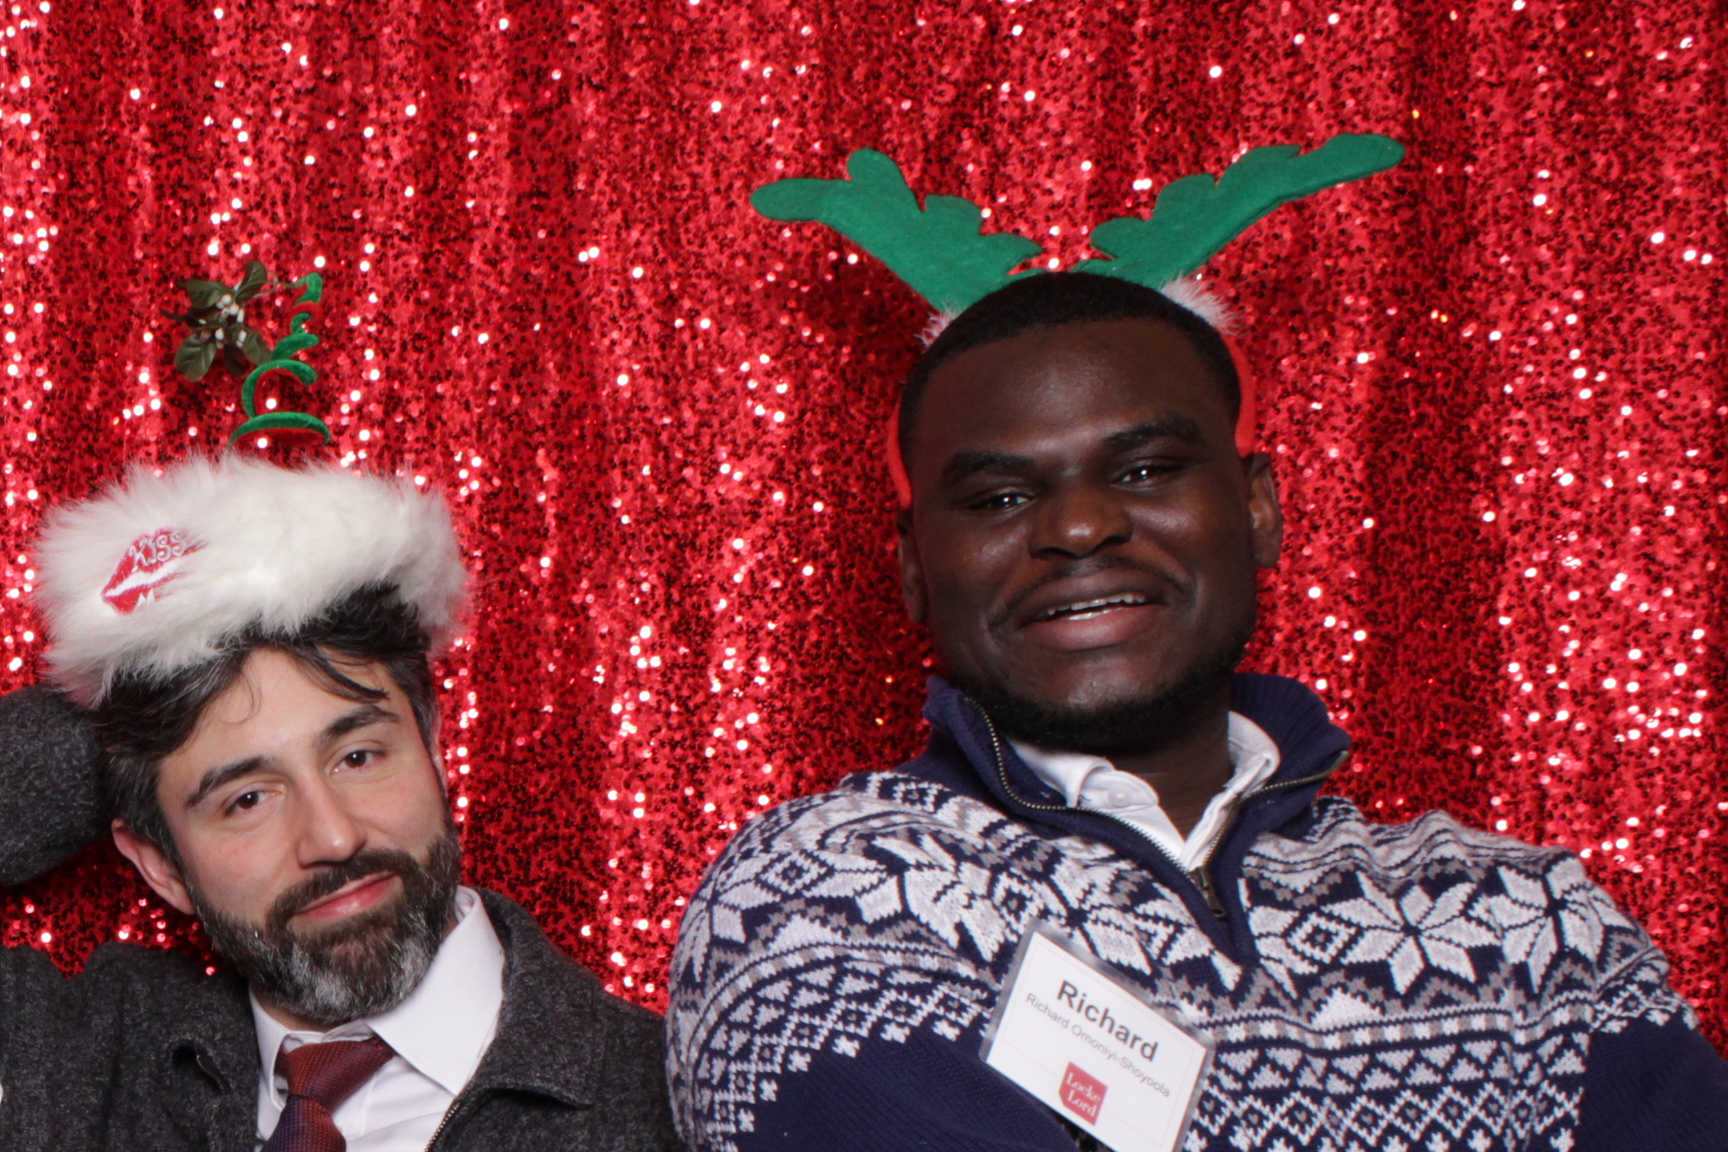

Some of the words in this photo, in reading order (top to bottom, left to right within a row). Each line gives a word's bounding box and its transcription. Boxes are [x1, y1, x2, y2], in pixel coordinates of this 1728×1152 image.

[1025, 993, 1070, 1029] Richard
[1056, 980, 1159, 1062] Richard
[1065, 1071, 1101, 1103] Locke
[1067, 1090, 1099, 1117] Lord
